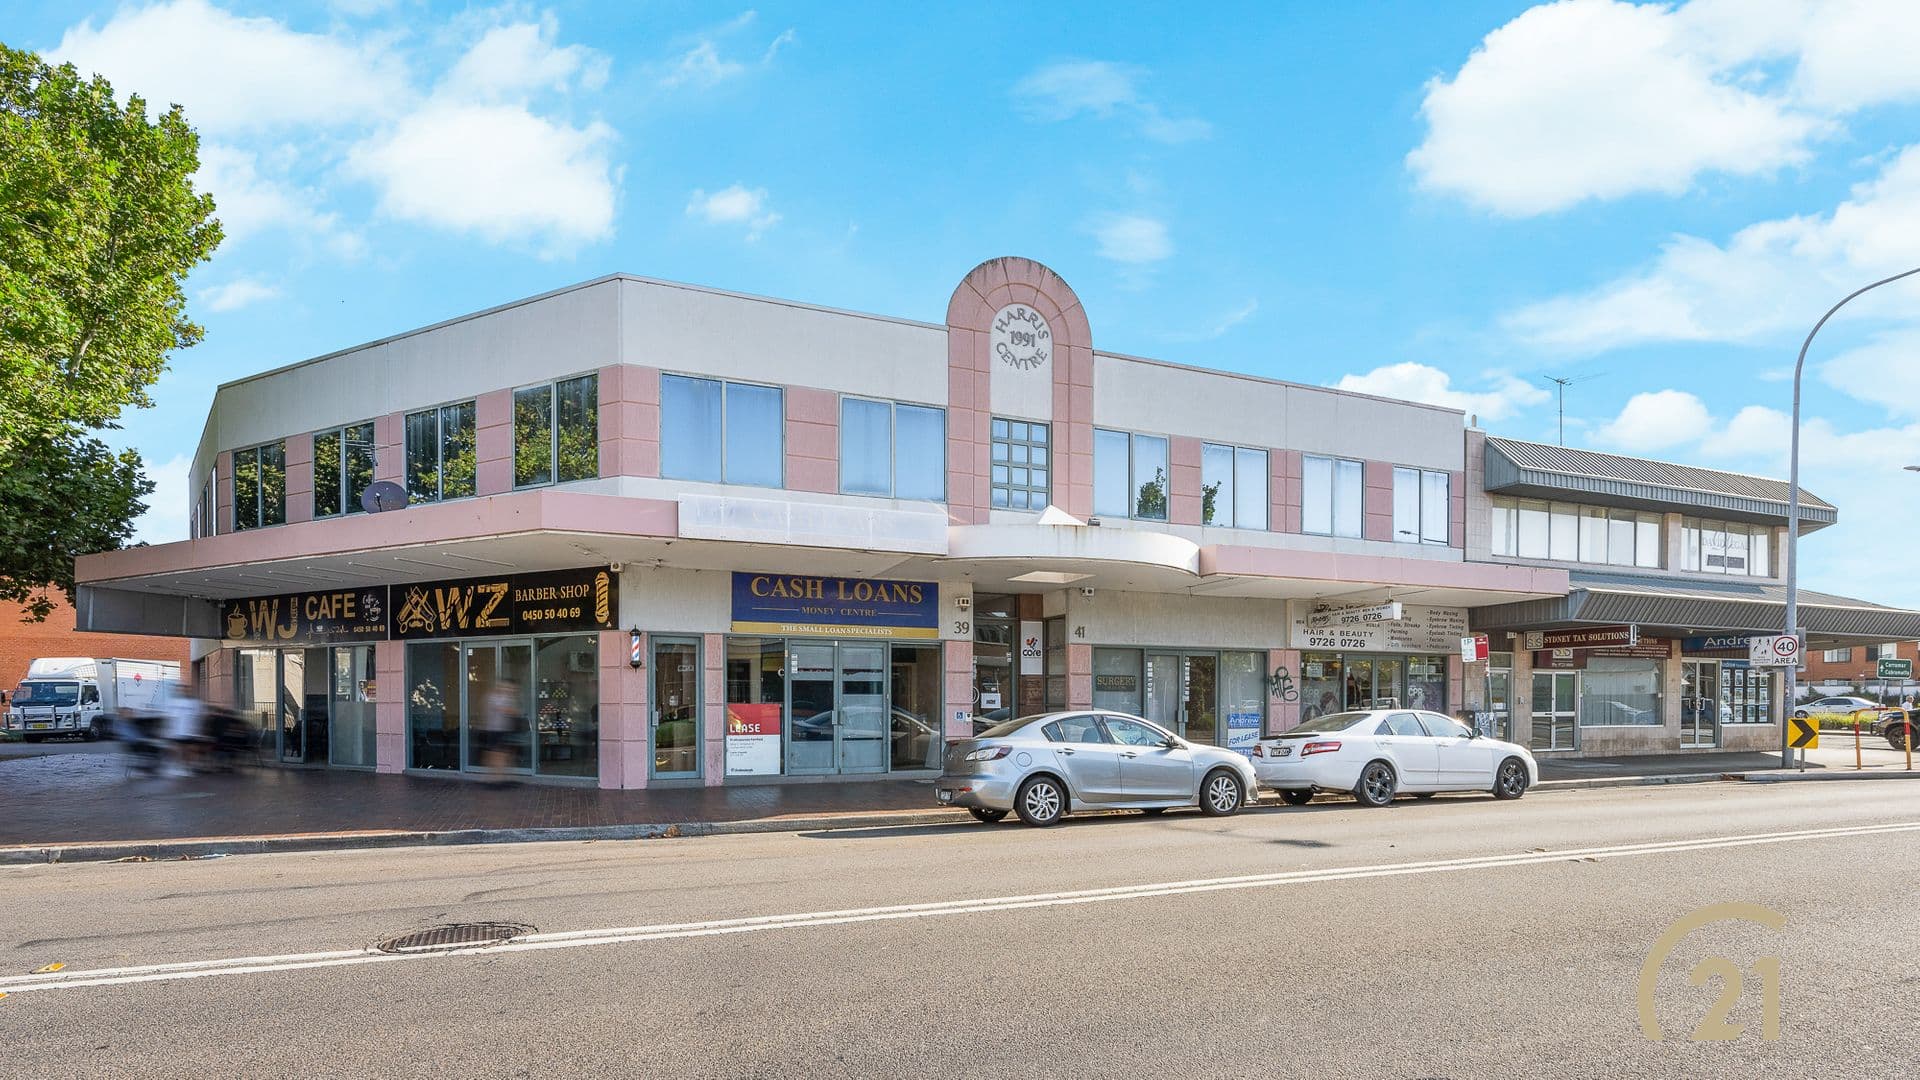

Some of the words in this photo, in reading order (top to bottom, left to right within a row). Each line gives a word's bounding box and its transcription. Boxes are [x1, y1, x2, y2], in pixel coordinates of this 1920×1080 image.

[995, 307, 1049, 340] HARRIS
[1010, 330, 1036, 348] 1991
[996, 342, 1048, 370] CENTRE
[514, 586, 557, 602] BARBER
[560, 584, 590, 598] SHOP
[751, 576, 824, 600] CASH
[837, 580, 922, 604] LOANS
[305, 593, 356, 621] CAFE
[435, 582, 510, 630] WZ
[801, 606, 836, 616] MONEY
[840, 608, 878, 617] CENTRE
[248, 597, 298, 640] WJ
[522, 608, 543, 621] 0450
[545, 608, 555, 620] 50
[557, 607, 568, 619] 40
[569, 606, 581, 618] 69
[1341, 616, 1360, 624] 9726
[1363, 612, 1382, 620] 0726
[780, 624, 798, 632] THE
[799, 624, 824, 633] SMALL
[954, 621, 969, 634] 39
[1074, 626, 1085, 639] 41
[1310, 638, 1336, 646] 9726
[1340, 638, 1366, 648] 0726
[1543, 636, 1570, 644] SYDNEY
[1573, 634, 1586, 642] TAX
[1588, 631, 1629, 641] SOLUTIONS
[1704, 636, 1750, 647] Andre
[1022, 648, 1041, 657] core
[1777, 642, 1794, 651] 40
[1097, 676, 1135, 686] SURGERY
[730, 724, 760, 733] LEASE
[1241, 732, 1258, 742] LEASE
